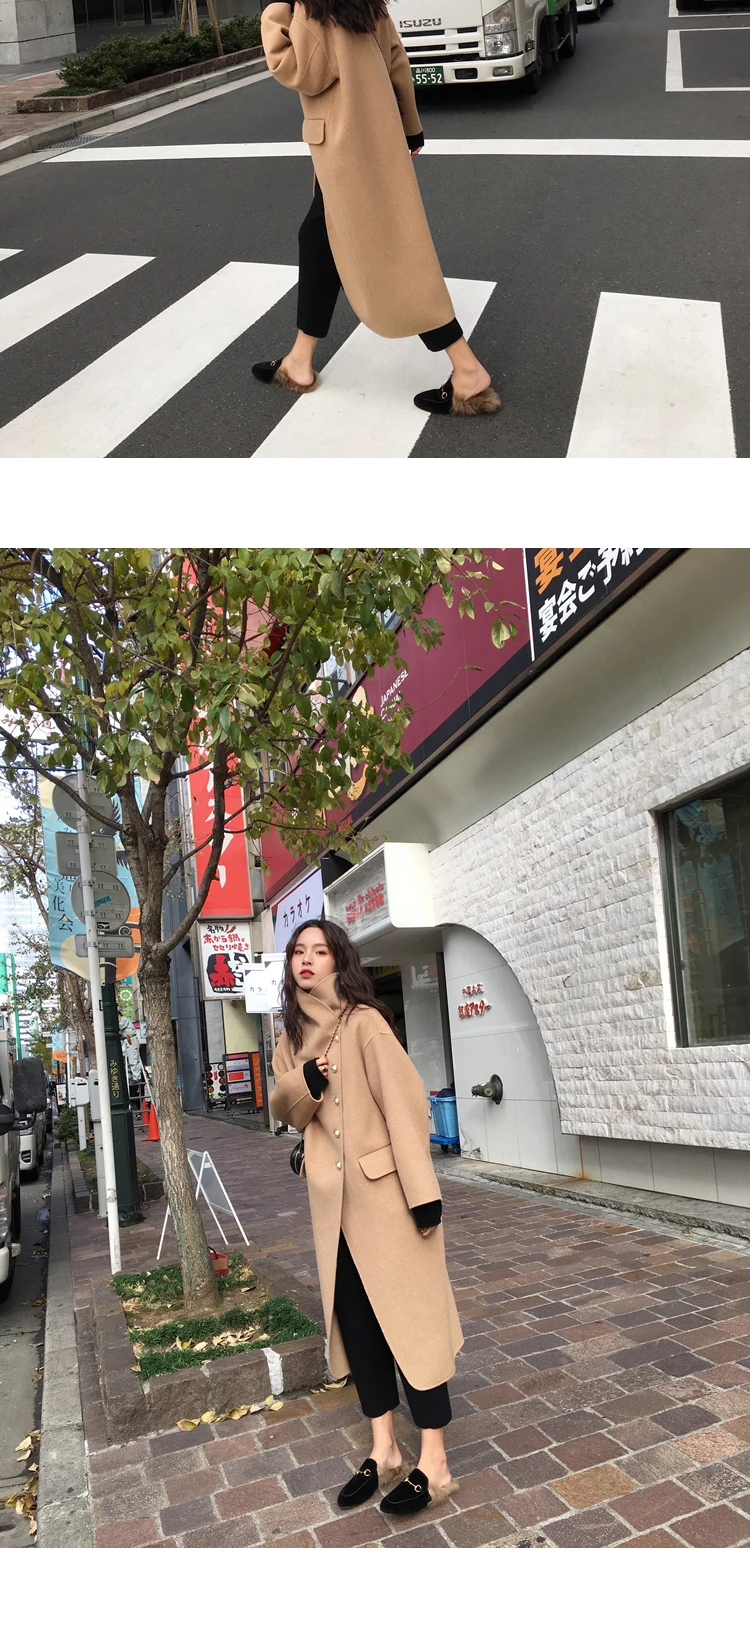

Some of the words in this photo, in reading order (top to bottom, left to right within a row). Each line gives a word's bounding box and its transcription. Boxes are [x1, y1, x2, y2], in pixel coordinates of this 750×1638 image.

[399, 18, 442, 29] ISUZU
[415, 73, 443, 84] 55-52
[283, 894, 311, 928] カラオケ
[207, 924, 224, 934] 名物
[110, 1060, 119, 1099] みゆき通り
